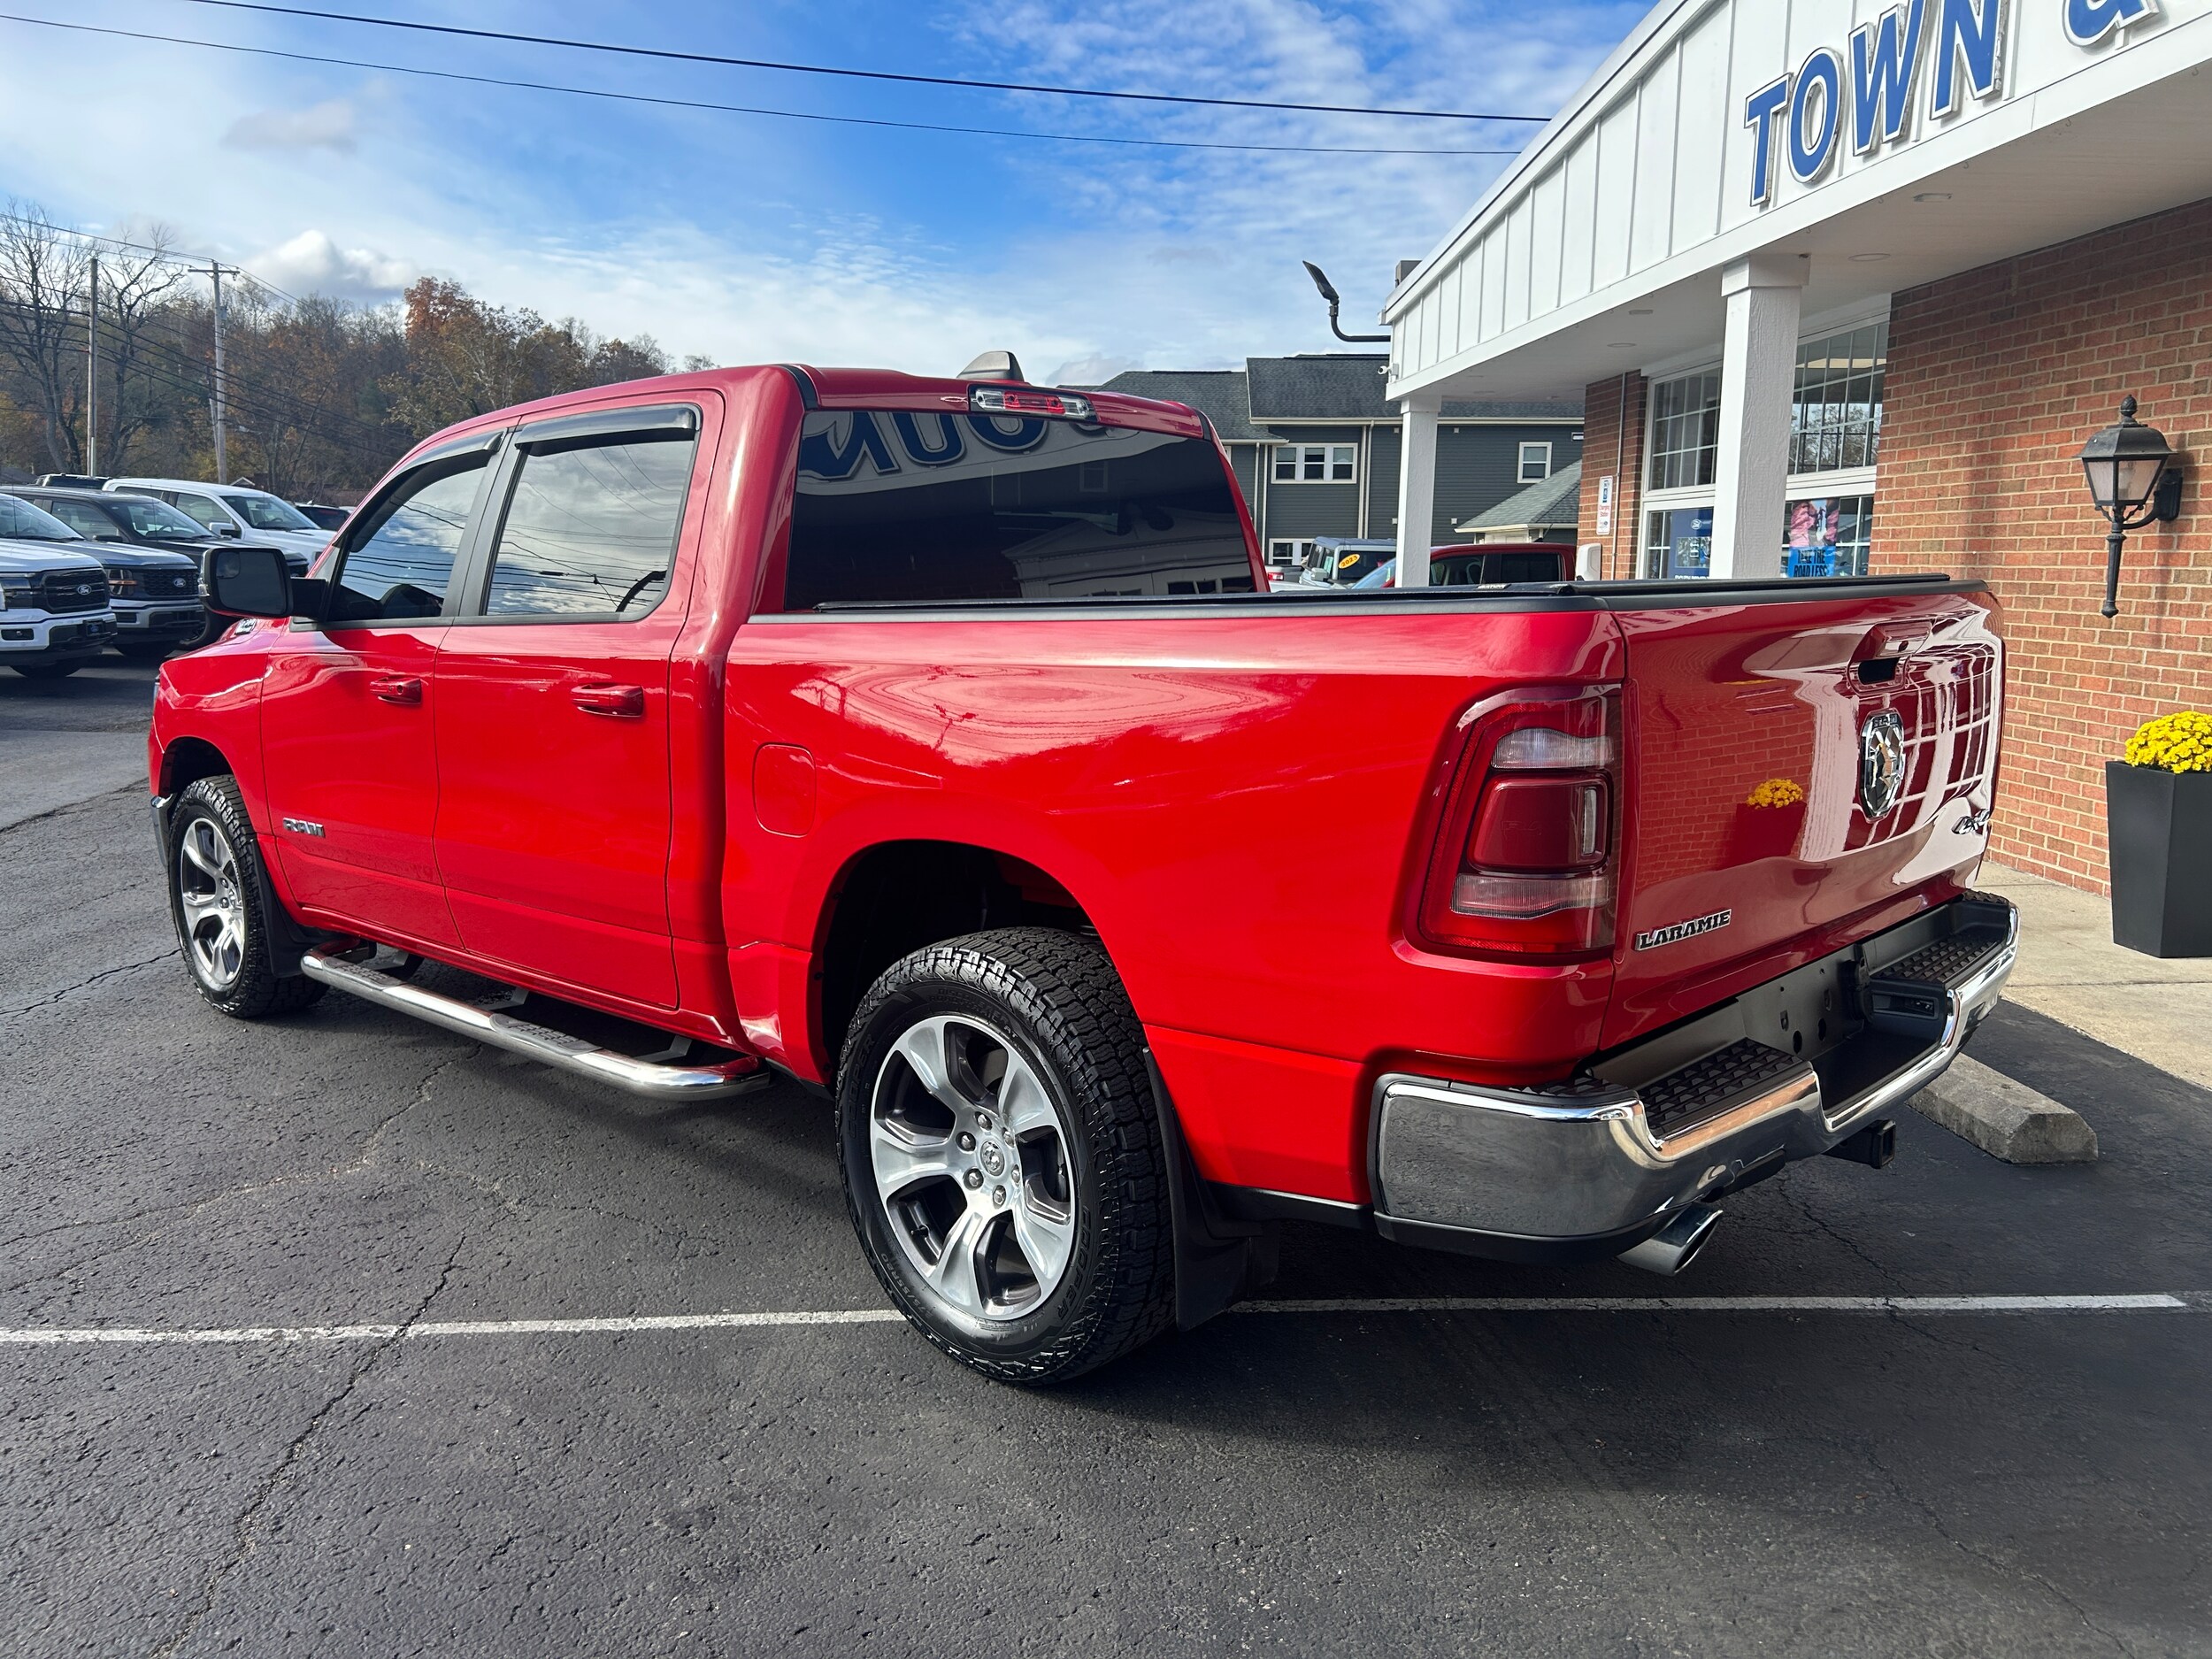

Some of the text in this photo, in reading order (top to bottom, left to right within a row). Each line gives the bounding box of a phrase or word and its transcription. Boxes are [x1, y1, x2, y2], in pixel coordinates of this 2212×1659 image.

[1743, 0, 2001, 207] TOWN
[1340, 555, 1358, 567] 2023
[282, 817, 326, 838] RAM
[1635, 909, 1732, 951] LARAMIE
